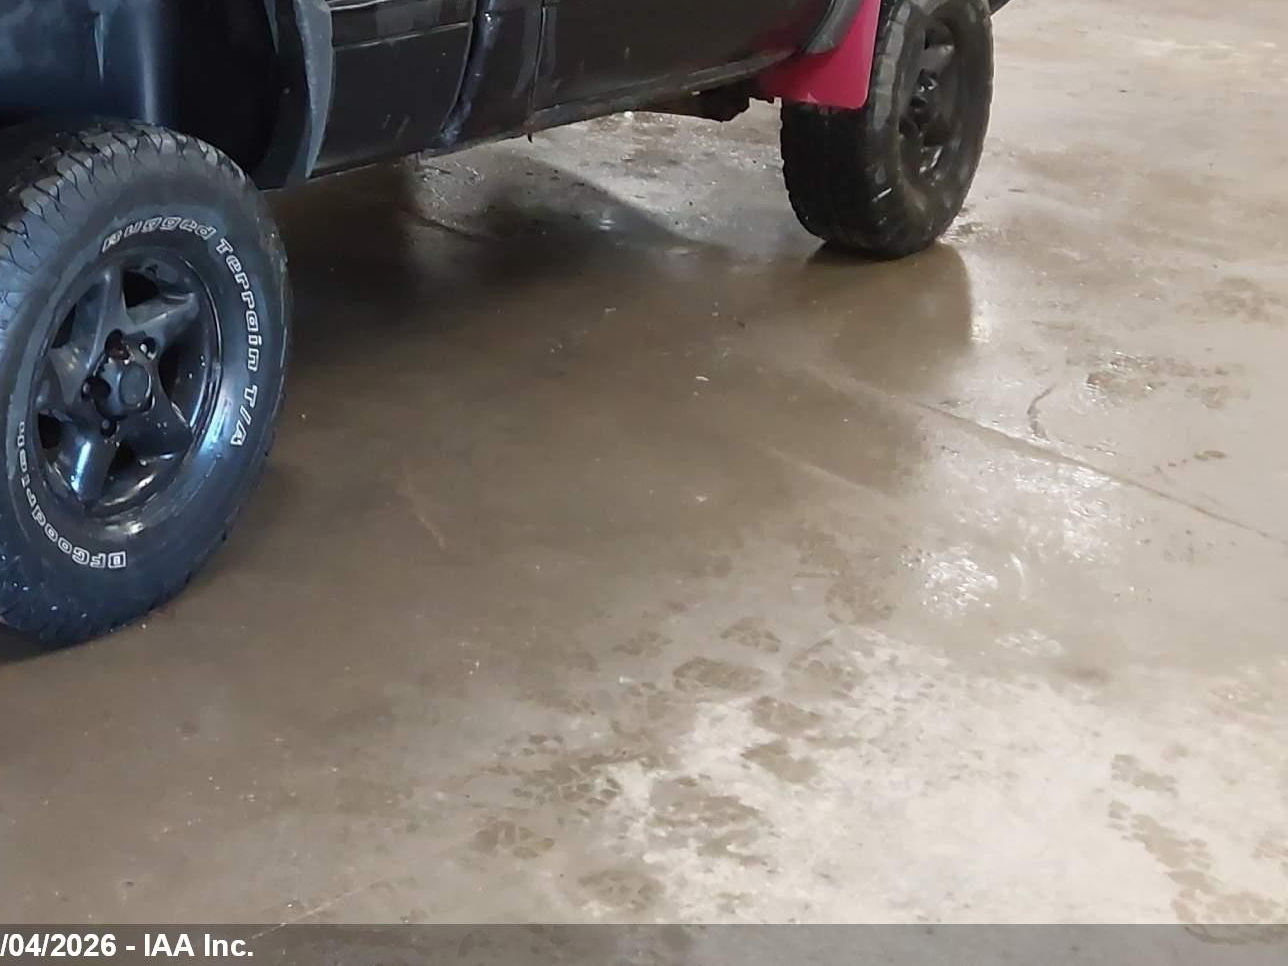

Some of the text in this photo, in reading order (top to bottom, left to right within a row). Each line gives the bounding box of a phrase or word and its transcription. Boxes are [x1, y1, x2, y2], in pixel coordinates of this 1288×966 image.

[102, 216, 218, 253] Rugged
[216, 237, 262, 447] Terrain T/A
